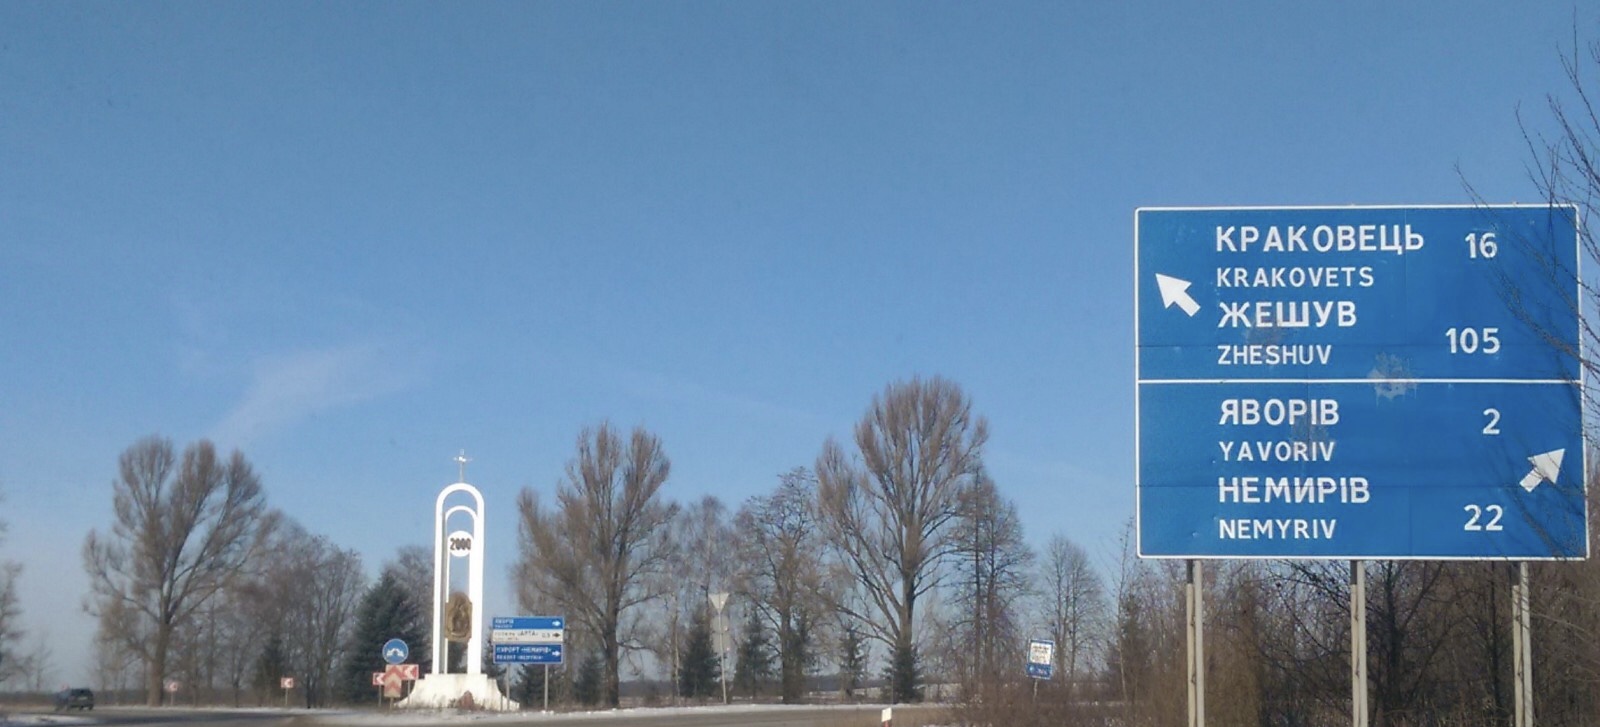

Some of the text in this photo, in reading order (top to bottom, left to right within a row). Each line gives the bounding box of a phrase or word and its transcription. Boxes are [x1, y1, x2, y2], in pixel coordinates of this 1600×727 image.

[1216, 224, 1498, 258] КРАКОВЕЦЬ 16
[1216, 266, 1374, 288] KRAKOVETS
[1218, 300, 1357, 328] ЖЕШУВ
[1445, 327, 1500, 354] 105
[1217, 344, 1332, 365] ZHESHUV
[1219, 398, 1500, 435] ЯВОРІВ 2
[1219, 441, 1335, 462] YAVORIV
[1218, 477, 1370, 504] НЕМИРІВ
[1219, 519, 1336, 539] NEMYRIV
[1464, 504, 1504, 531] 22
[450, 537, 471, 550] 2000
